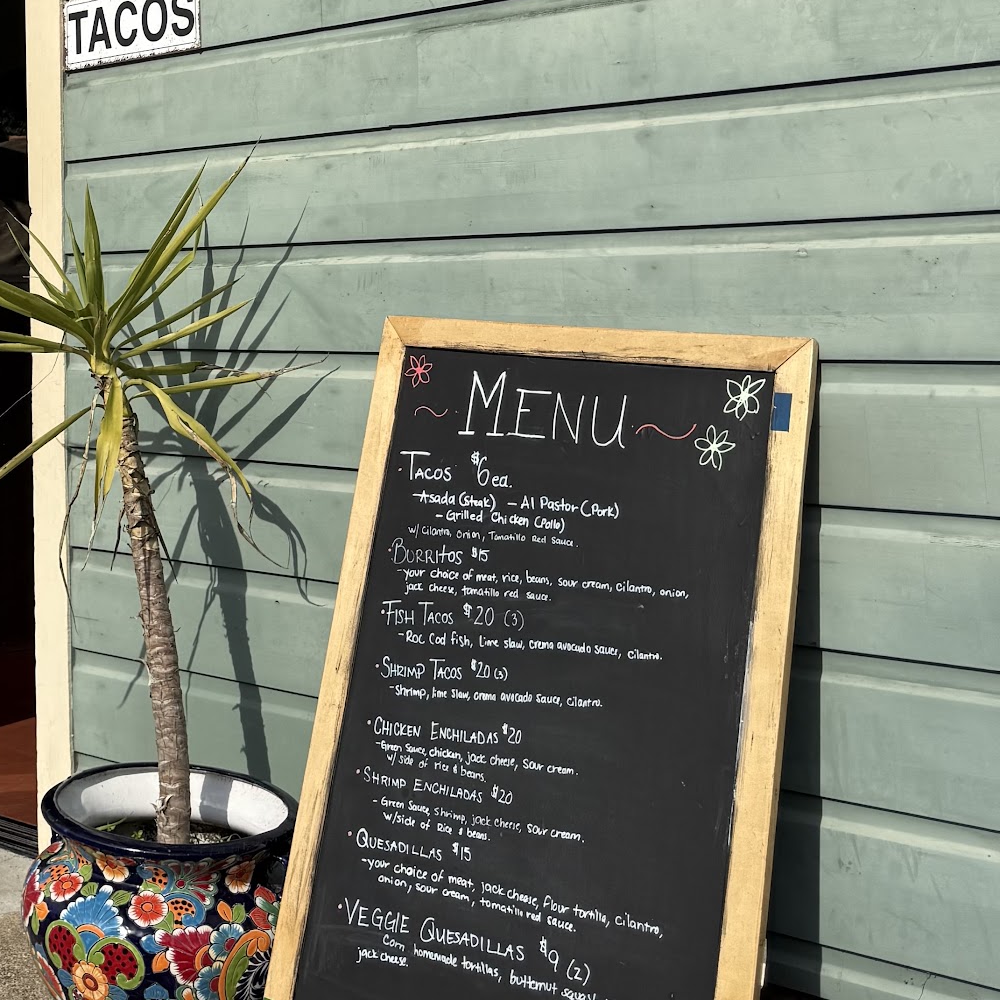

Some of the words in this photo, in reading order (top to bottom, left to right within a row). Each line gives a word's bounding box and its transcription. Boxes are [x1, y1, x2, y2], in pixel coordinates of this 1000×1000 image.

[457, 370, 628, 449] MENU
[540, 496, 579, 513] Pastor
[580, 499, 620, 519] (Pork)
[430, 567, 460, 580] choice
[462, 568, 475, 581] of
[502, 572, 522, 585] rice,
[525, 569, 553, 586] beans,
[581, 580, 613, 593] cream,
[503, 588, 519, 599] red
[450, 630, 474, 649] fish,
[393, 863, 428, 880] choice
[430, 868, 445, 883] of
[447, 873, 477, 893] meat,
[377, 874, 413, 894] onion,
[525, 911, 542, 923] red
[344, 897, 410, 934] VEGGIE
